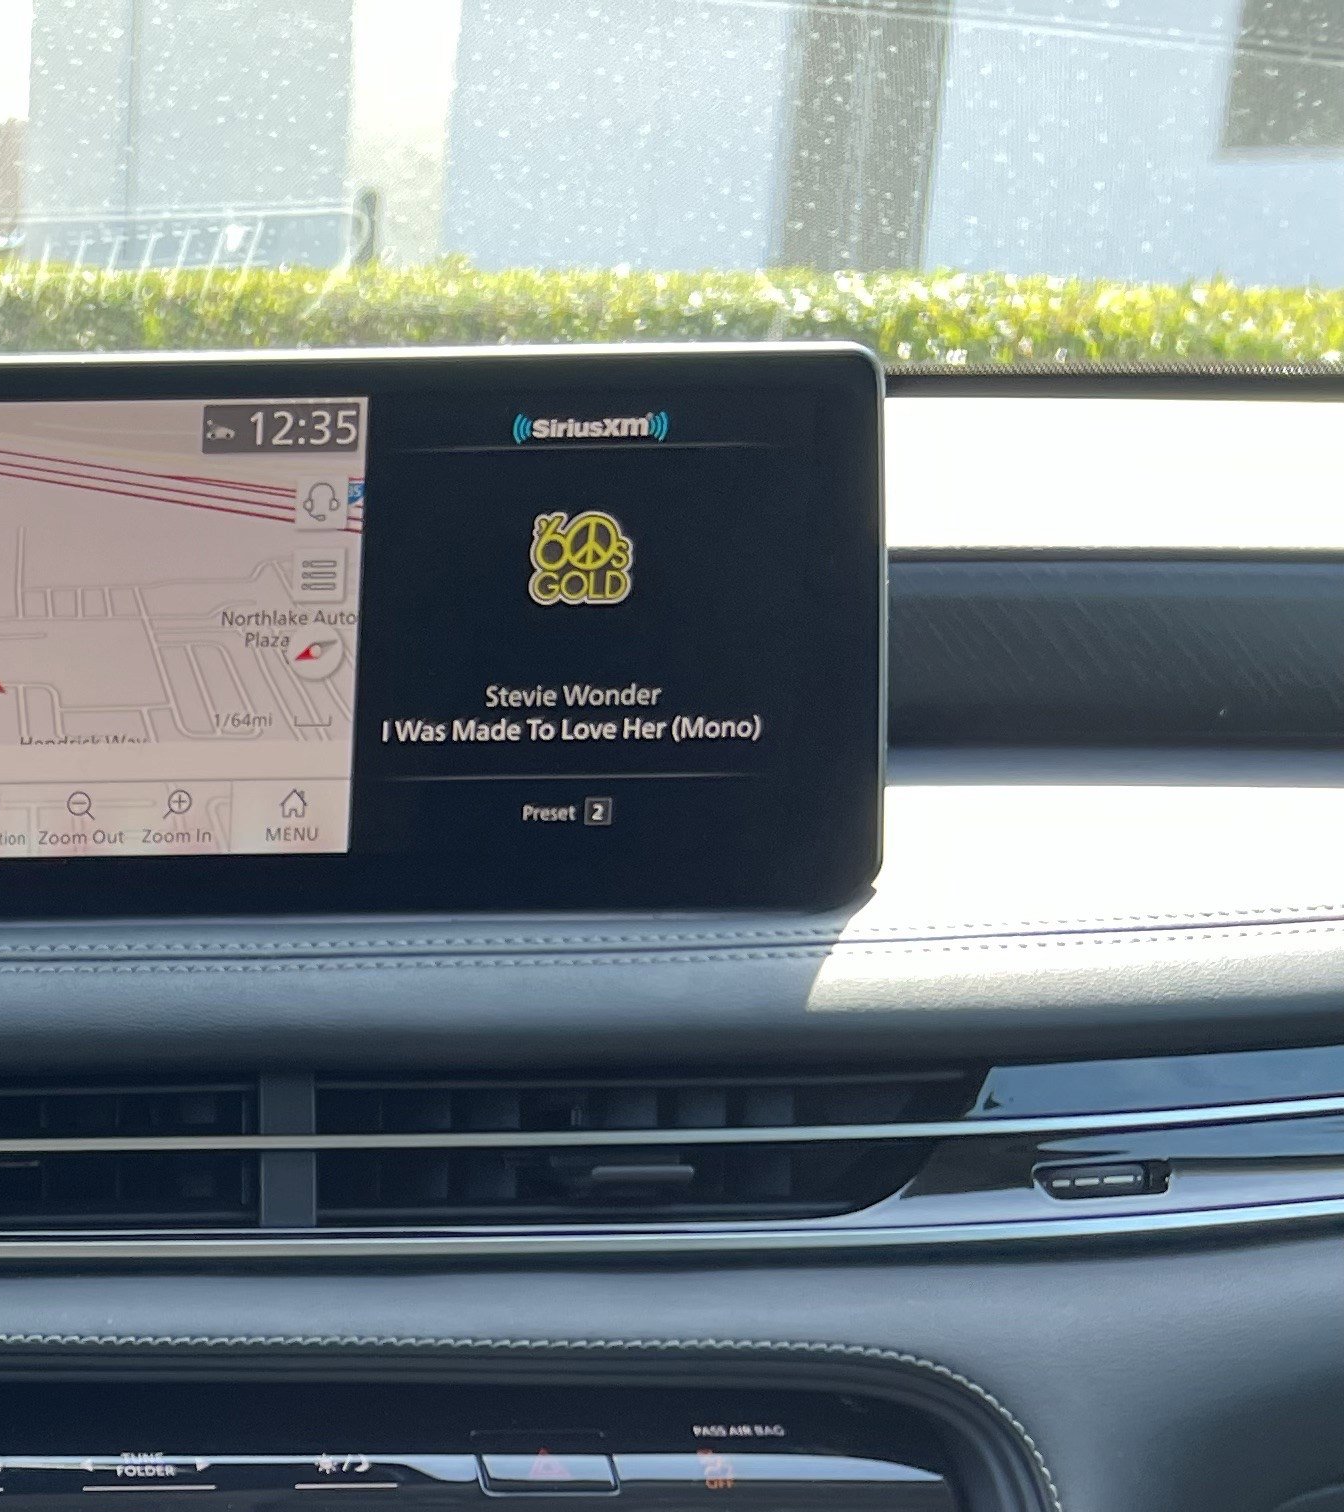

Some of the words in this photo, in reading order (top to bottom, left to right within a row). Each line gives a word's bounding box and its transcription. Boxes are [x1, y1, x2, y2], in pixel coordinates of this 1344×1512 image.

[250, 410, 358, 446] 12:35
[533, 570, 629, 600] GOLD
[221, 611, 308, 628] Northlake
[314, 610, 356, 626] Auto
[244, 631, 290, 649] Plaza
[485, 685, 557, 708] Stevie
[562, 683, 662, 707] Wonder
[214, 713, 272, 729] 1/64mi
[381, 720, 389, 742] I
[396, 720, 446, 742] Was
[452, 718, 521, 741] Made
[527, 719, 556, 741] To
[562, 718, 616, 740] Love
[622, 717, 667, 740] Her
[671, 714, 762, 742] (Mono)
[522, 805, 576, 821] Preset
[591, 804, 604, 820] 2
[38, 830, 87, 846] Zoom
[92, 829, 124, 845] Out
[142, 829, 191, 844] Zoom
[196, 828, 212, 843] In
[265, 826, 319, 843] MENU
[116, 1464, 176, 1477] FOLDER
